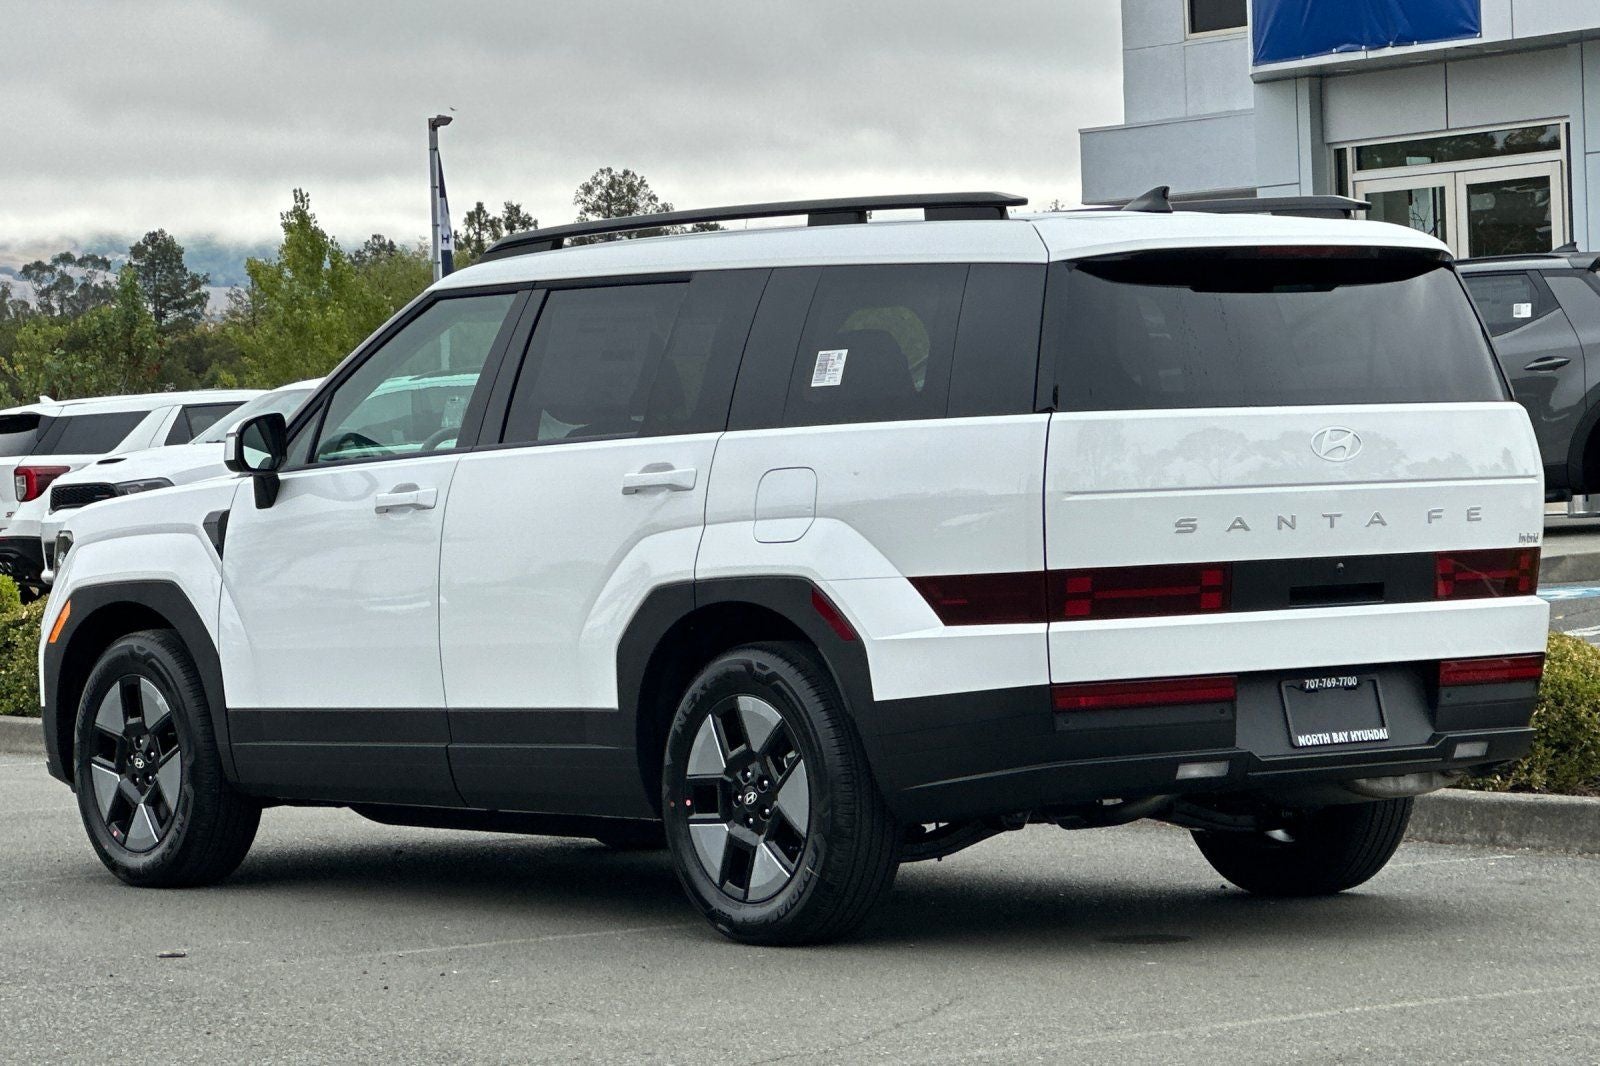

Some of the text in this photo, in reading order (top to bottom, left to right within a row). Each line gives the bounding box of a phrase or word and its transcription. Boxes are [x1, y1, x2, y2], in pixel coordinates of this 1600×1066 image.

[1174, 506, 1482, 534] SANTA FE
[1517, 532, 1539, 545] hybrid
[1304, 676, 1358, 689] 707-769-7700
[1297, 728, 1389, 747] NORTH BAY HYUNDAI
